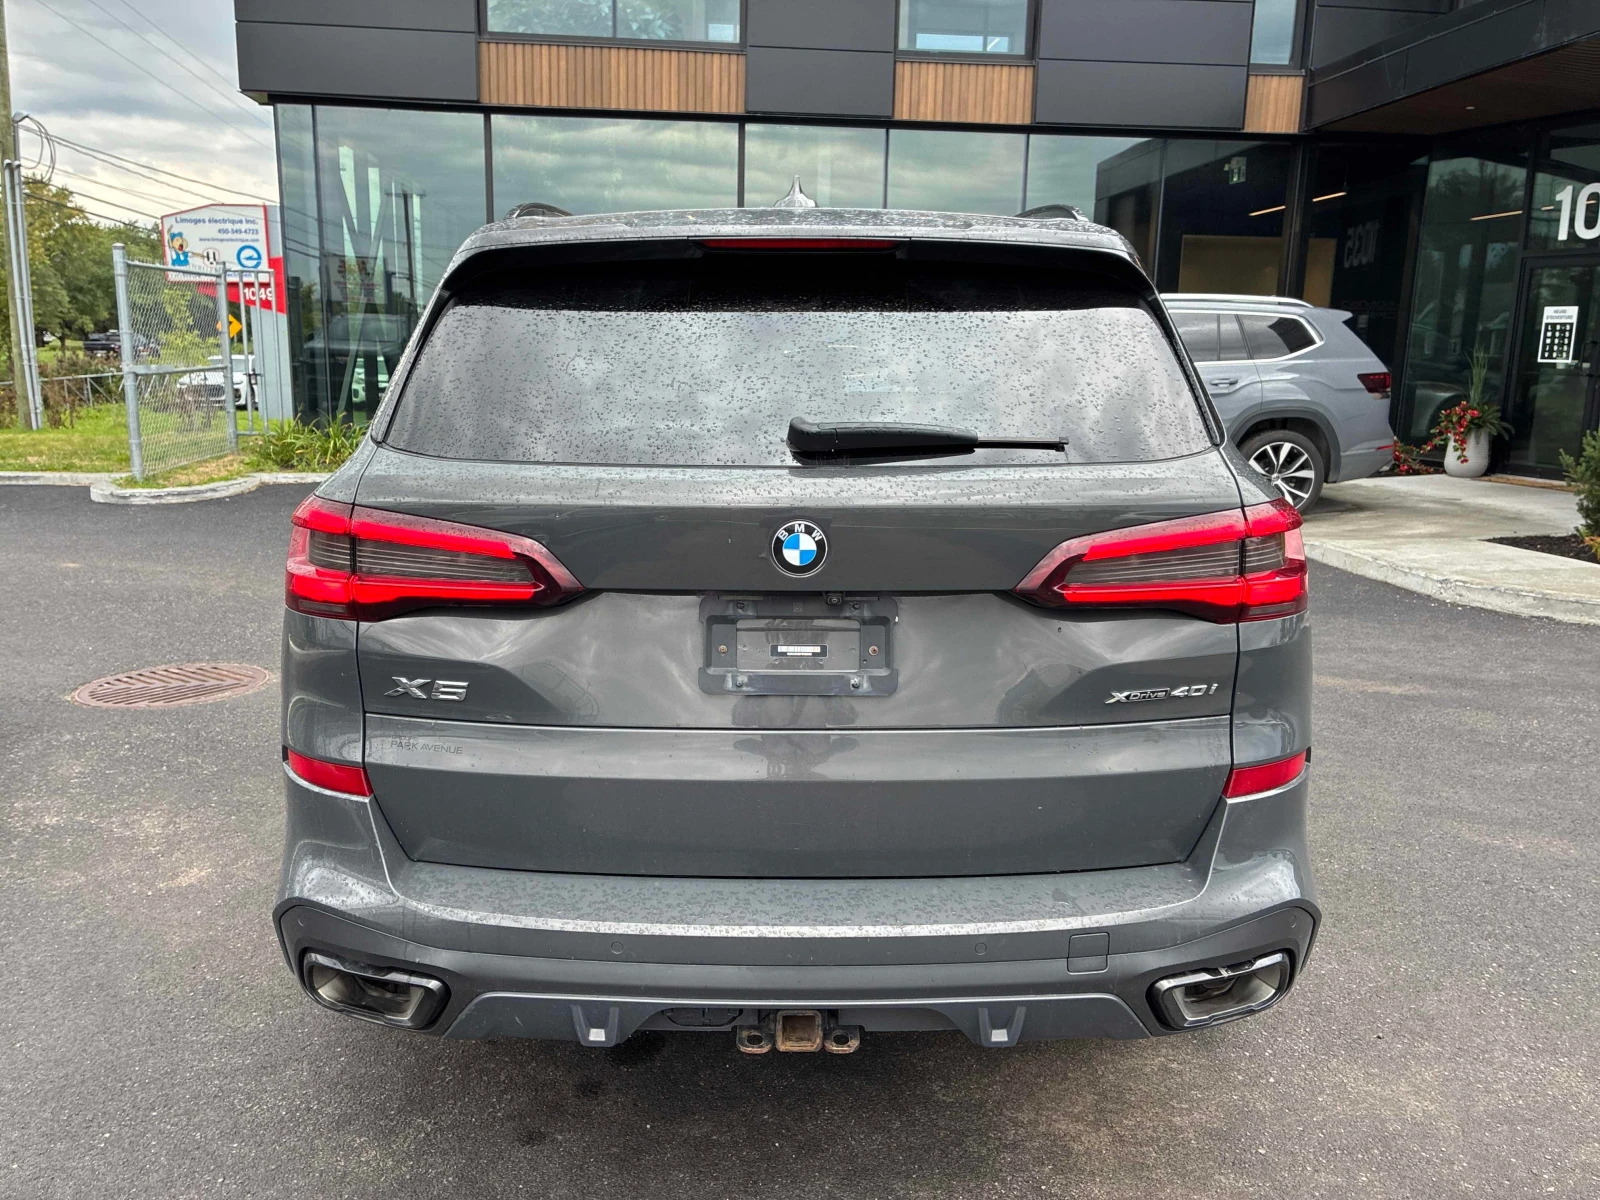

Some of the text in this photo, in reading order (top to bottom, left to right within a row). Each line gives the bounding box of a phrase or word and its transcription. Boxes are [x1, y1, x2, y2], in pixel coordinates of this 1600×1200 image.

[1555, 183, 1600, 240] 10
[175, 217, 206, 225] Limoges
[778, 523, 822, 541] BMW
[383, 676, 470, 702] X5
[390, 740, 464, 754] PARK AVENUE
